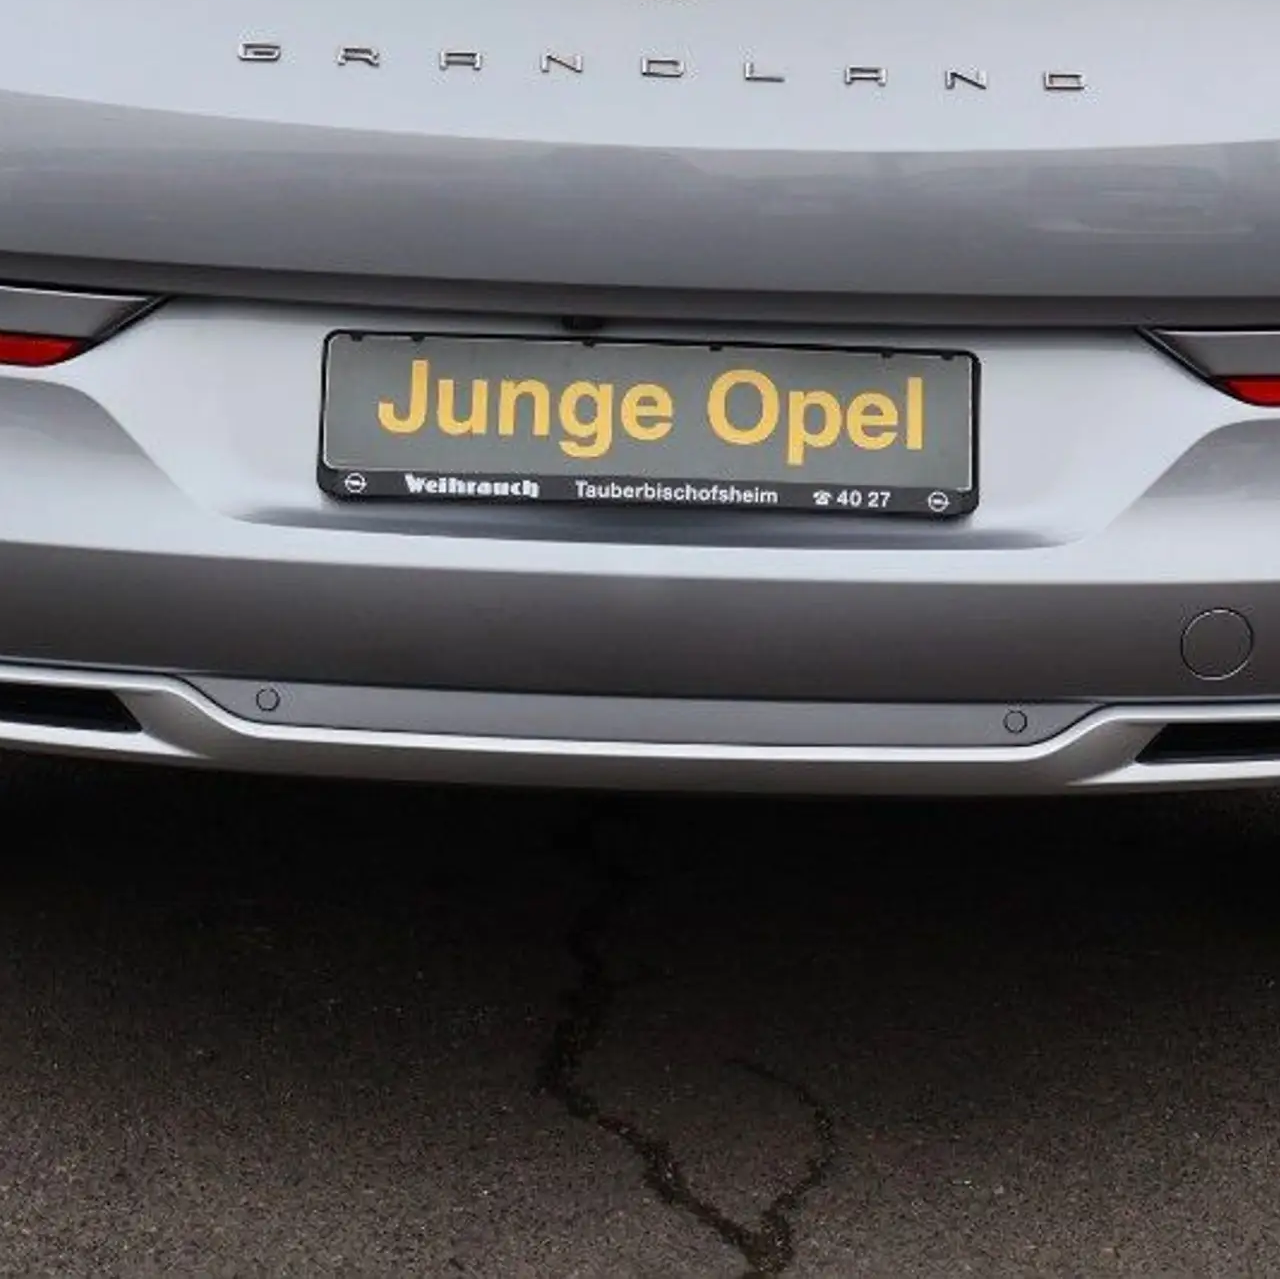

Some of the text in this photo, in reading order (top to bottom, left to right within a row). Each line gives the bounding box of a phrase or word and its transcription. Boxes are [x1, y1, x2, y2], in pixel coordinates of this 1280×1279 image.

[237, 41, 1086, 93] GRANDLAND
[376, 358, 923, 466] Junge Opel
[404, 473, 891, 509] Weihrauch Tauberbischofsheim 40 27
